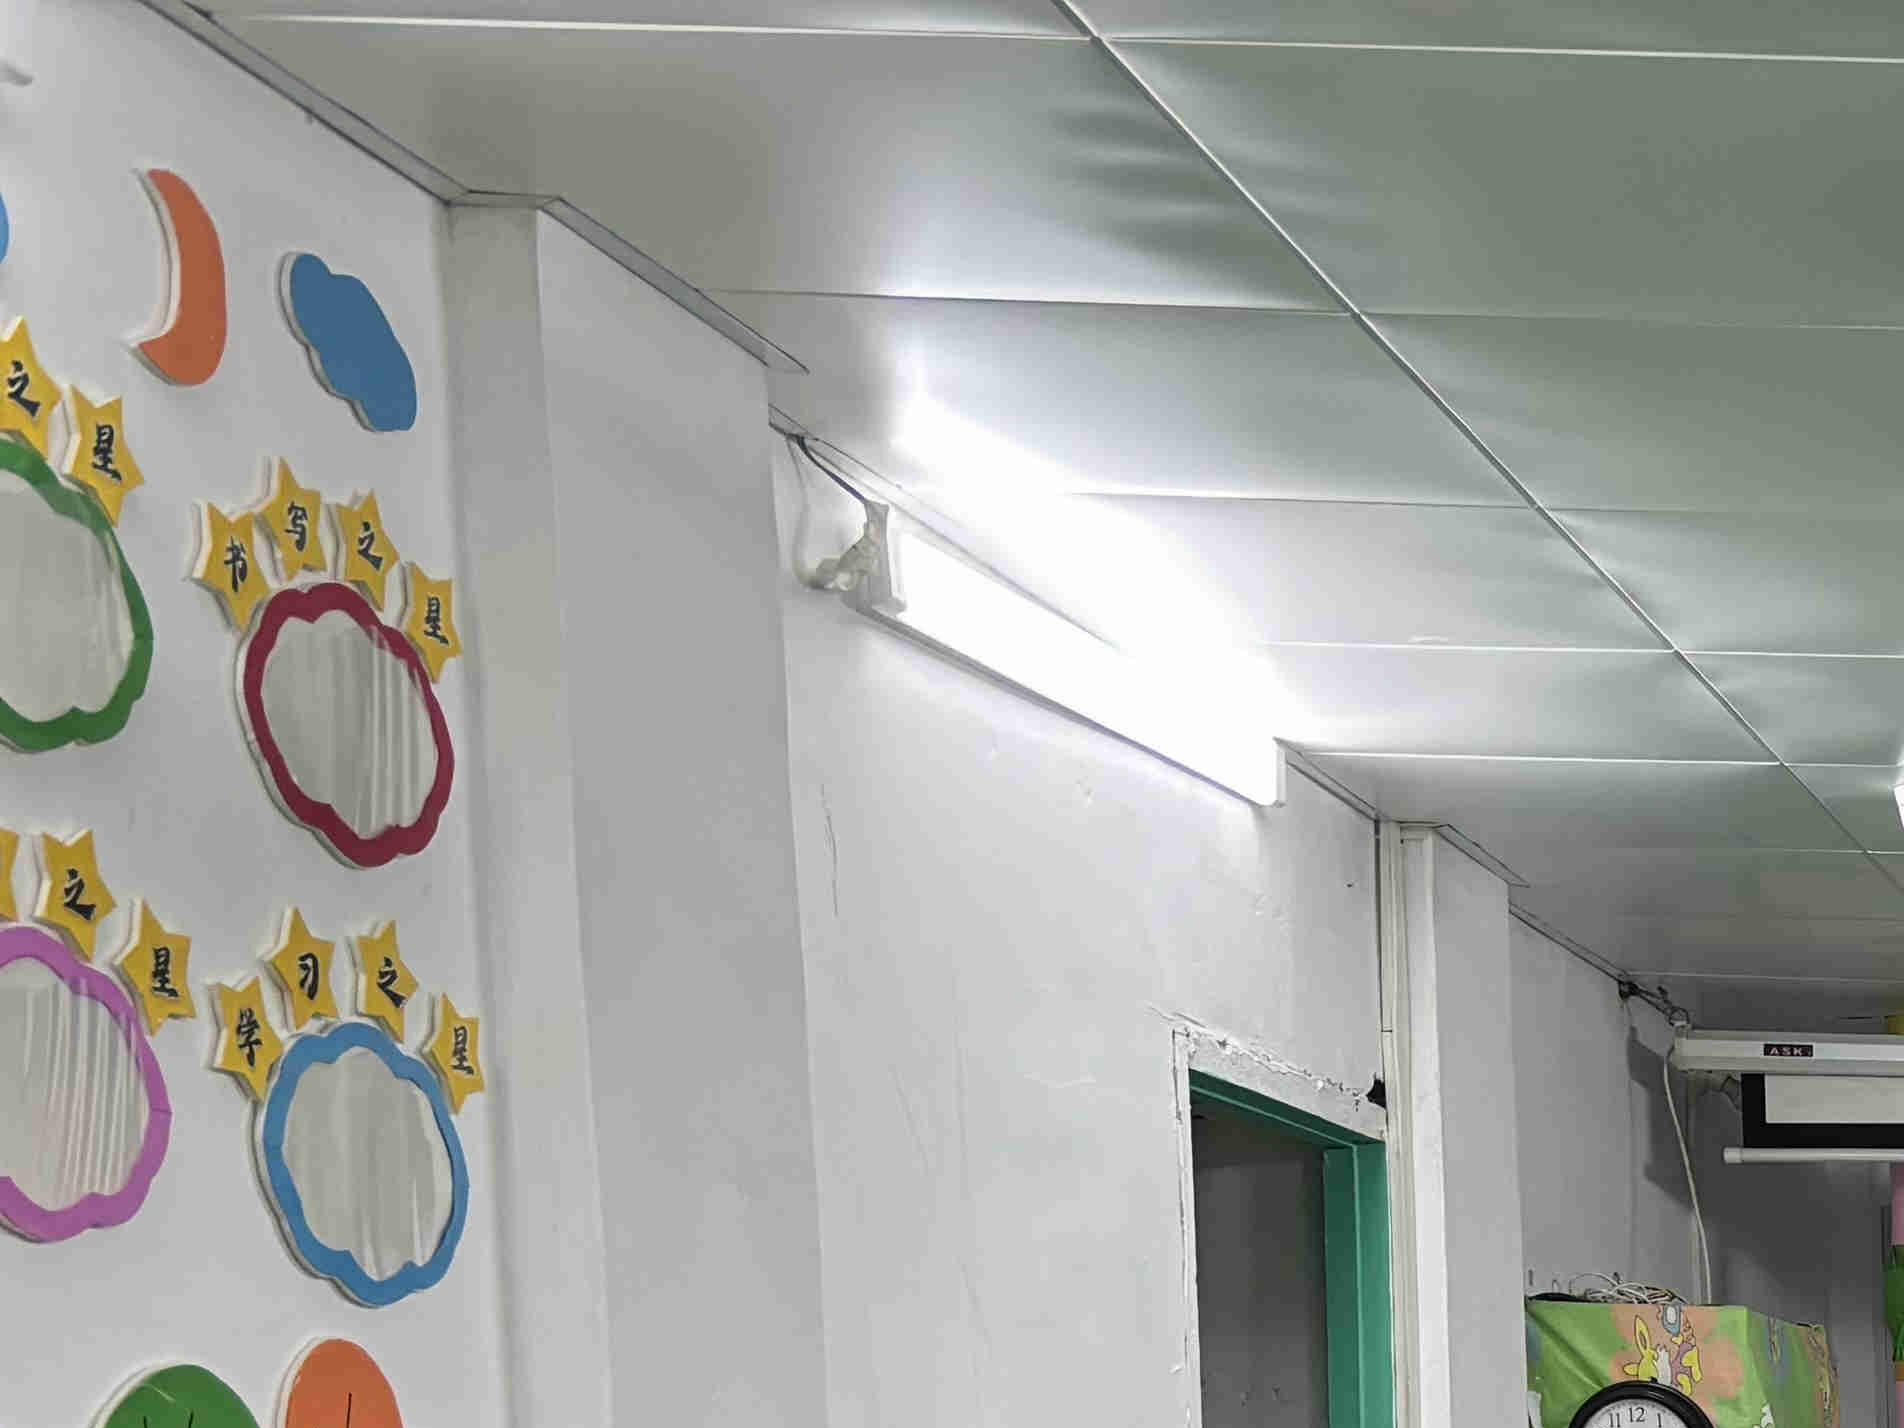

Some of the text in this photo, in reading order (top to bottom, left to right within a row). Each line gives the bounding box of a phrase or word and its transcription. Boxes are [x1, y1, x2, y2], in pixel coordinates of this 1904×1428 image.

[223, 502, 450, 645] 书写之星
[235, 950, 474, 1077] 学习之星
[1609, 1413, 1620, 1428] 11
[1628, 1407, 1645, 1422] 12
[1657, 1413, 1662, 1428] 1
